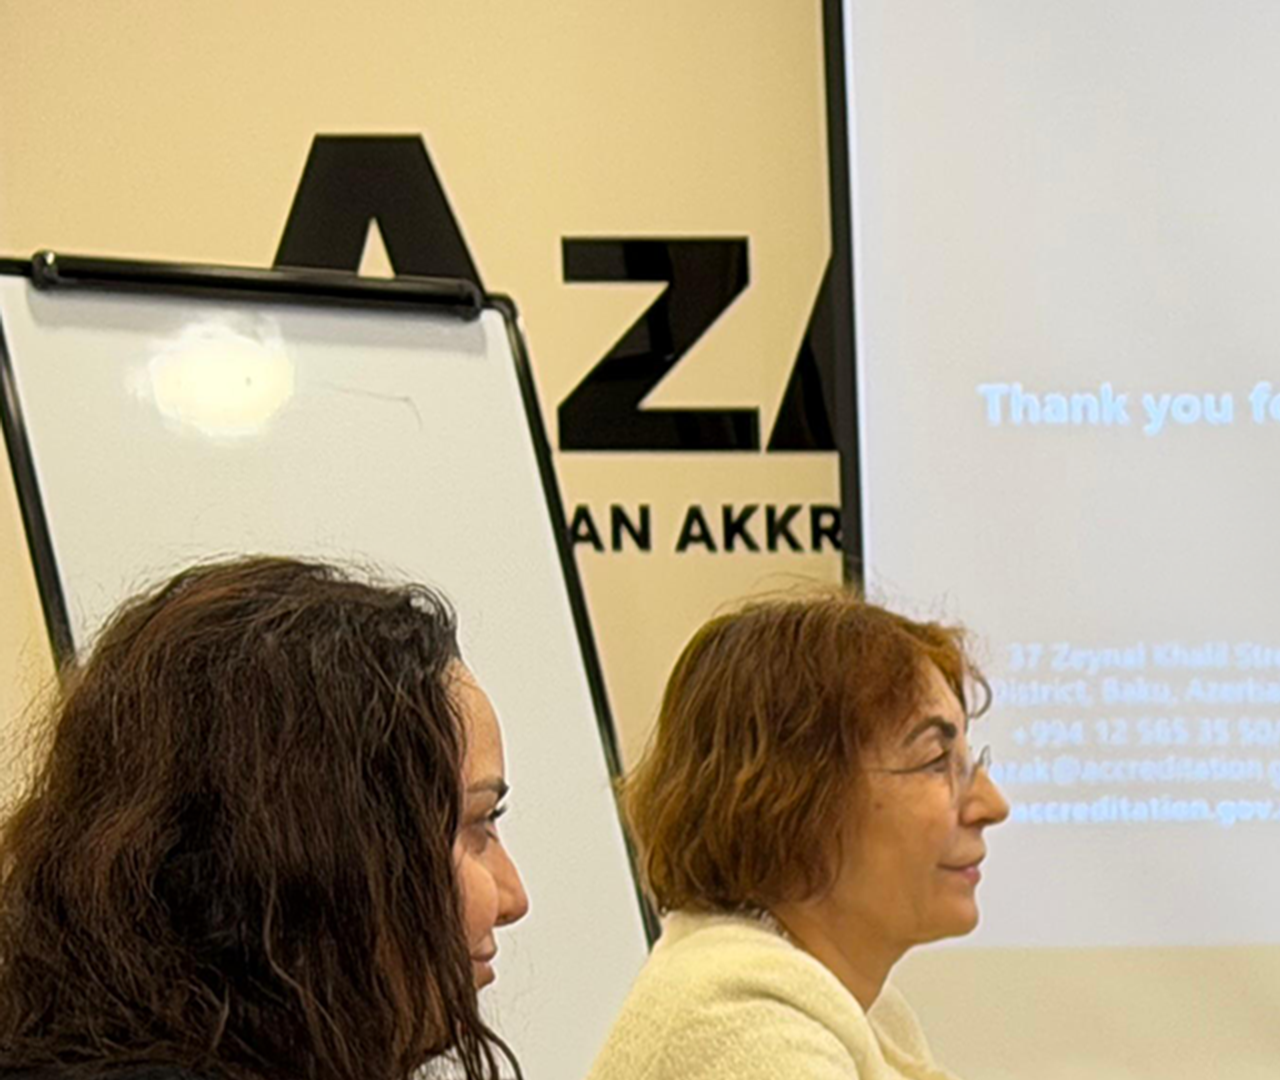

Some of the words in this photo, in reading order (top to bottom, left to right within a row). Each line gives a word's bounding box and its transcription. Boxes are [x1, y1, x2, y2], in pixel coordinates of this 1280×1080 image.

[978, 382, 1131, 427] Thank
[1142, 392, 1235, 437] you
[1051, 642, 1147, 675] Zeynal
[1102, 677, 1178, 707] Baku,
[1013, 718, 1085, 746] +994
[1096, 718, 1129, 746] 12
